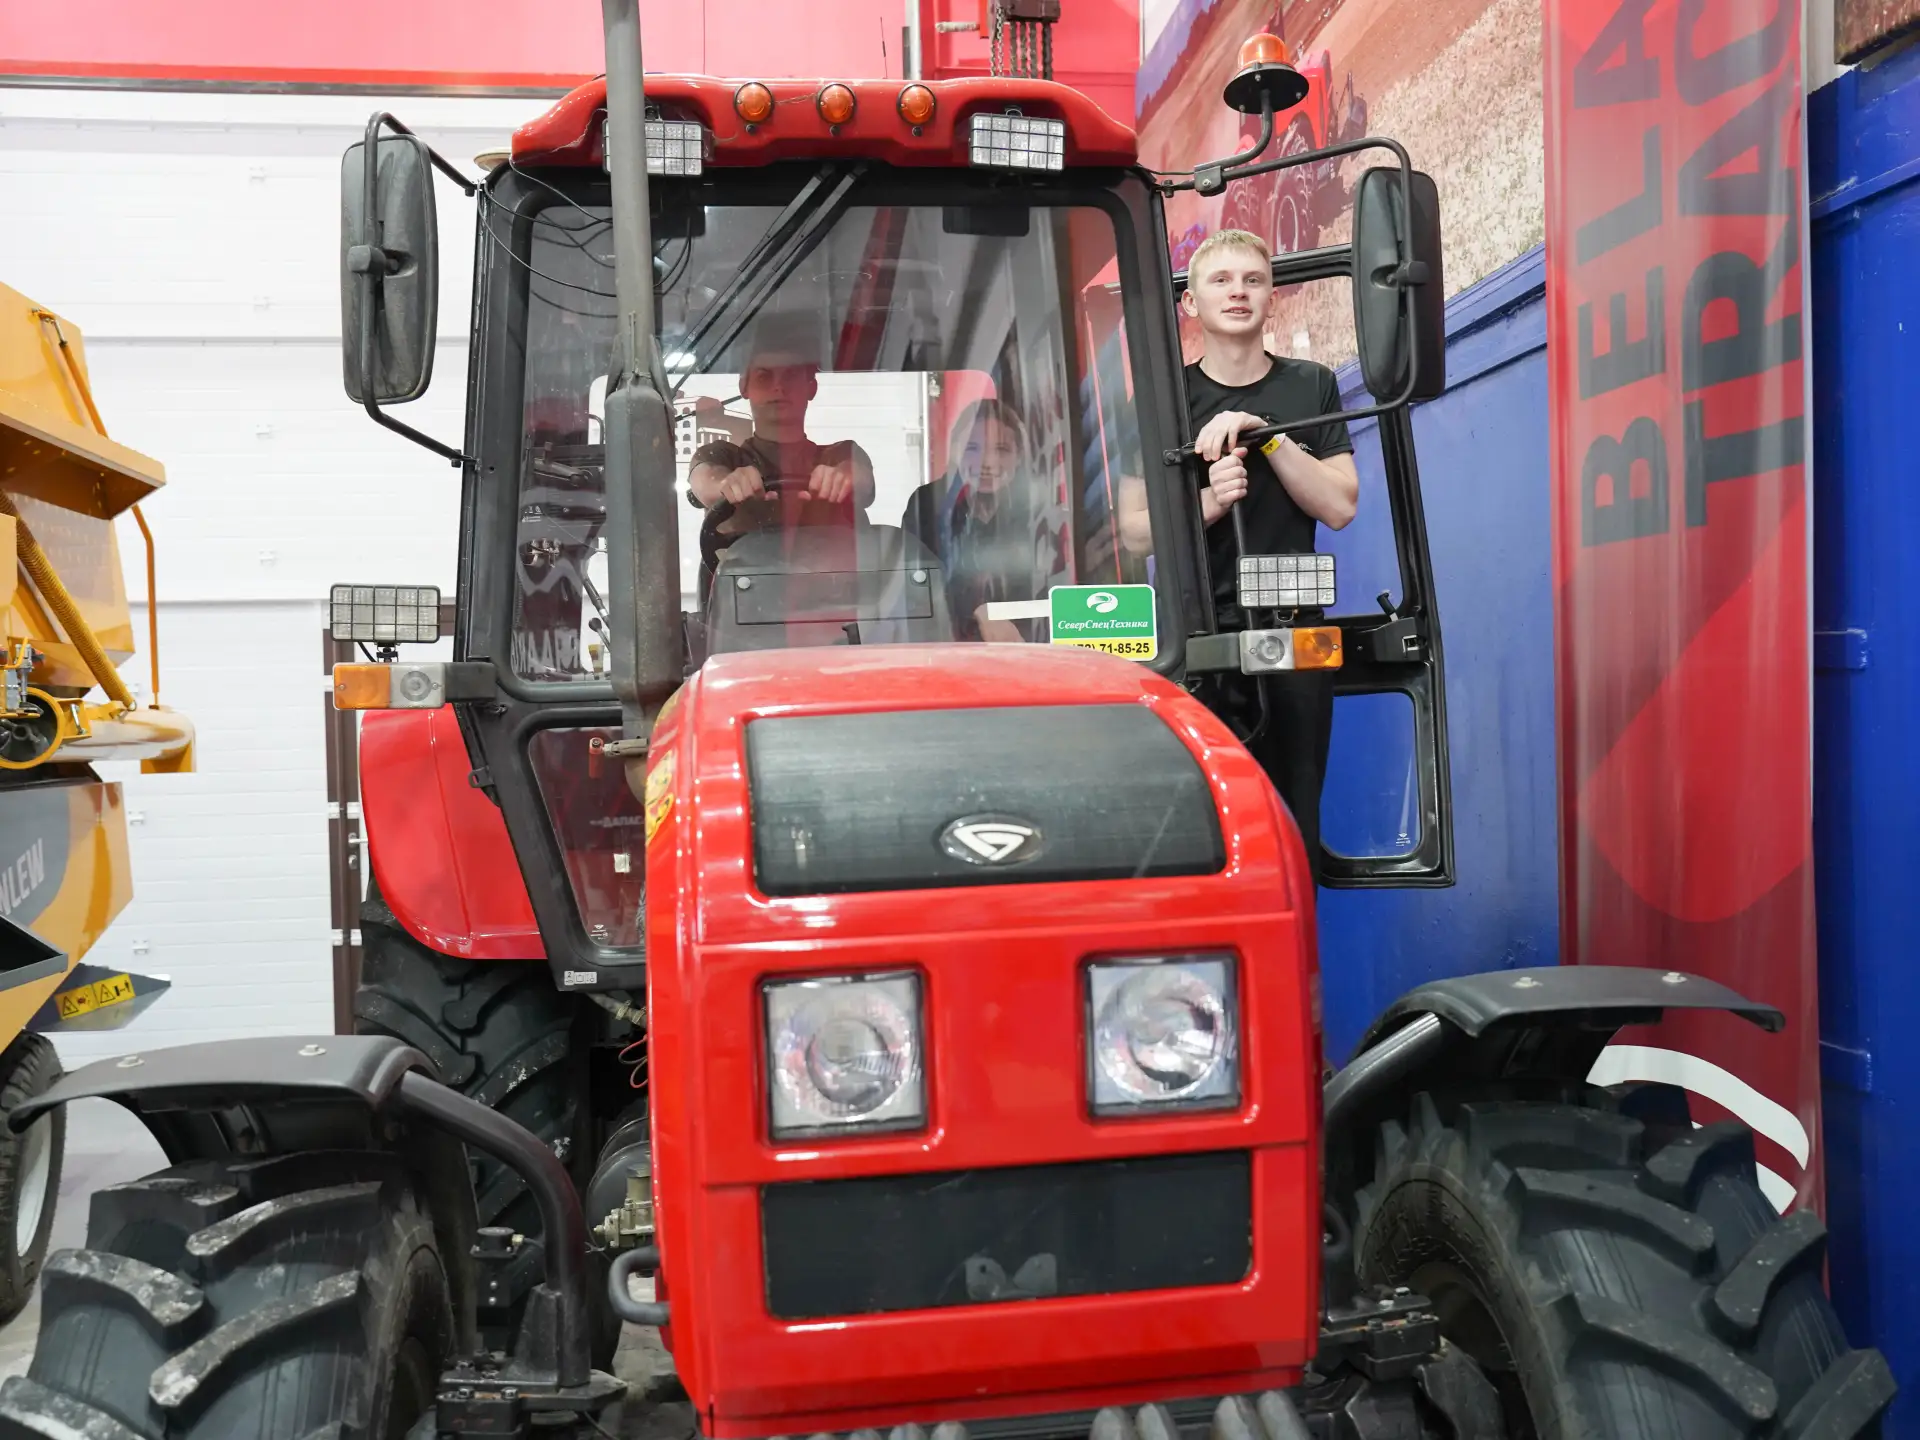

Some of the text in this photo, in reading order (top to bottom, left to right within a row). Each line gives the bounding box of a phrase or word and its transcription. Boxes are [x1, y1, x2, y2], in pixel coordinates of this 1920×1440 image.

[1576, 0, 1669, 547] BELA
[1058, 620, 1148, 631] СеверСпецТехника
[1100, 643, 1149, 653] 71-85-25
